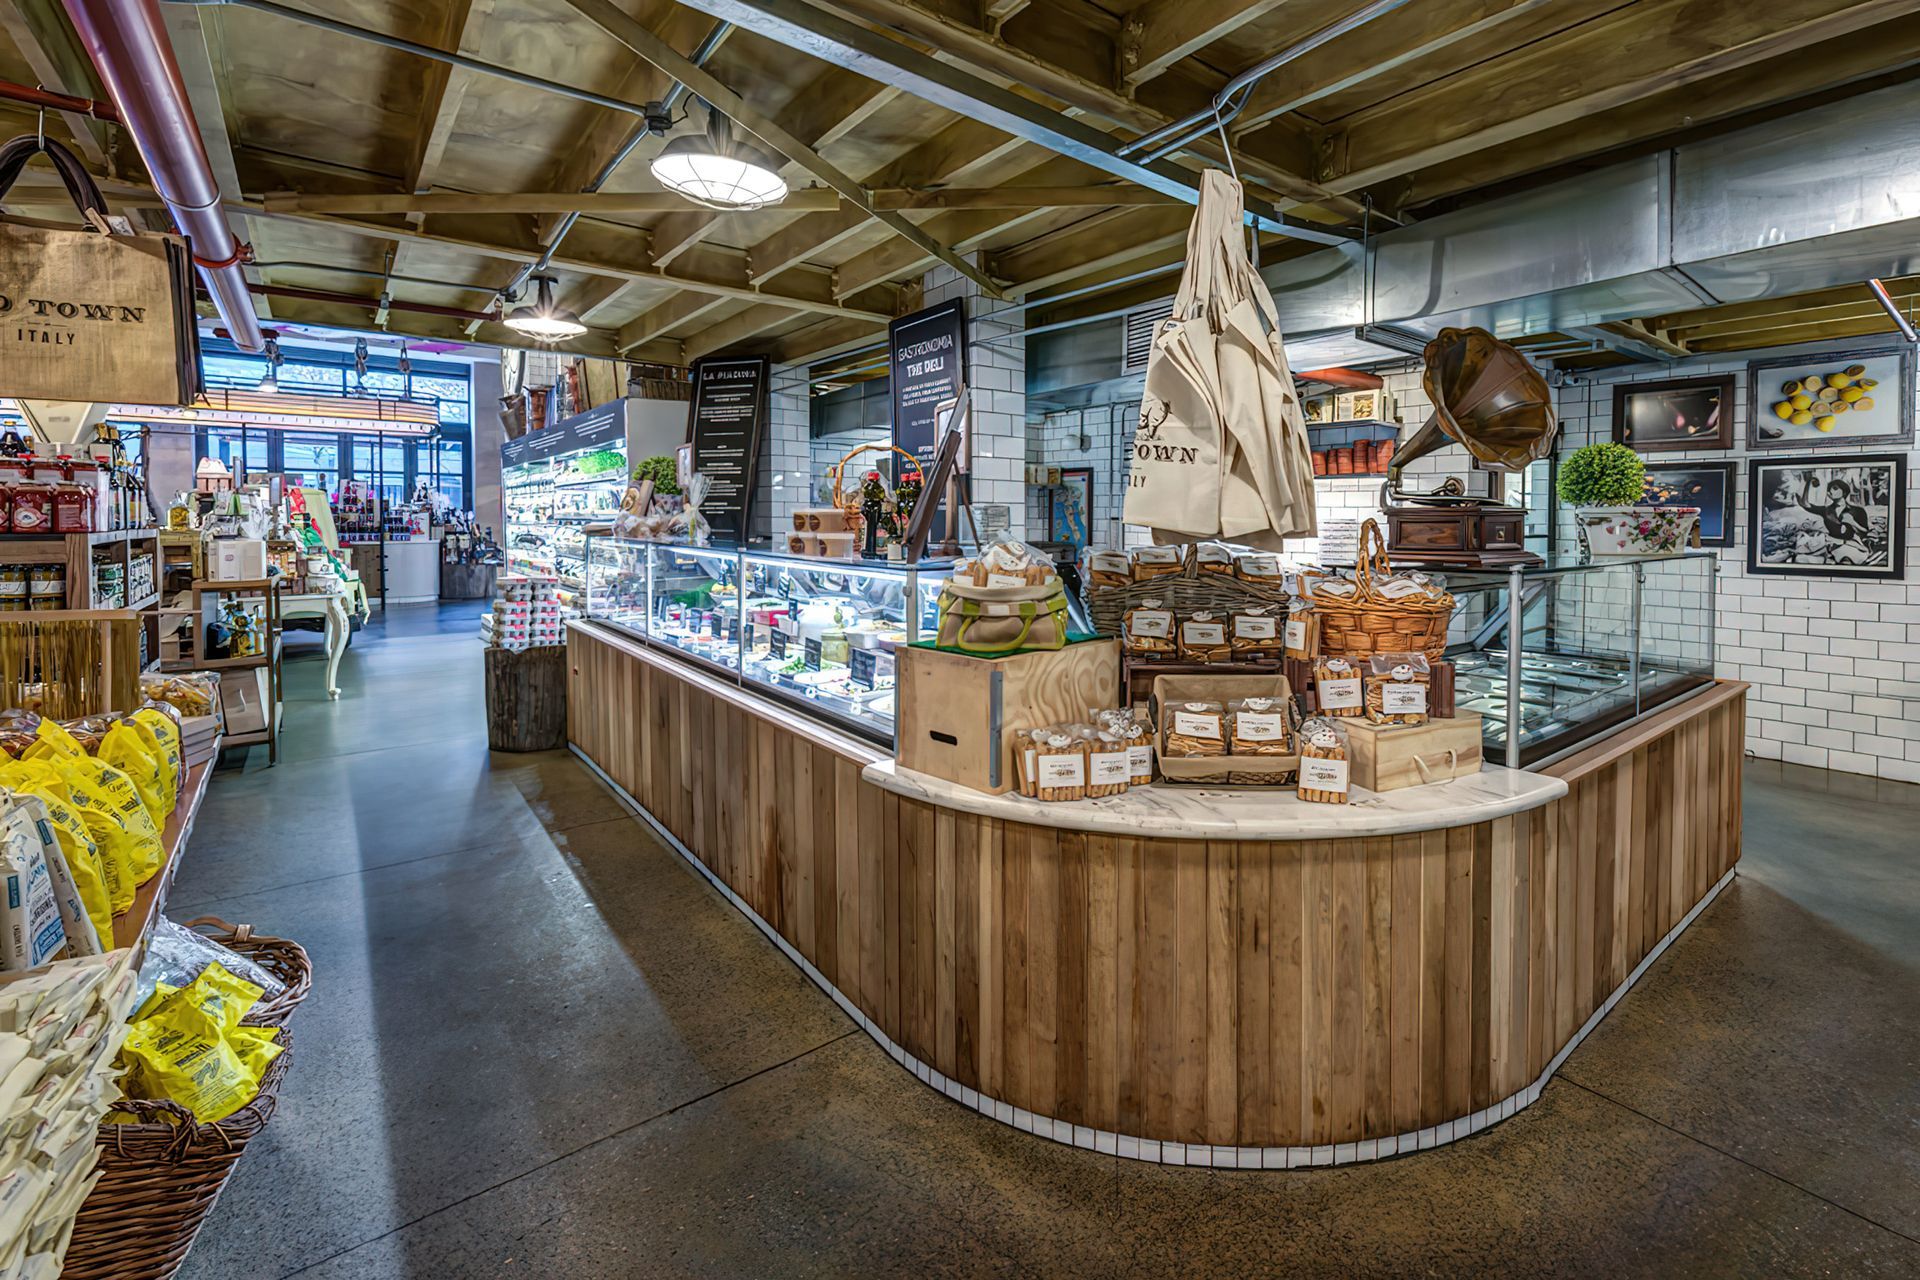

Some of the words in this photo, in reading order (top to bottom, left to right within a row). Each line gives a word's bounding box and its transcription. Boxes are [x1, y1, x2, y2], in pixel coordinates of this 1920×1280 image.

[28, 298, 147, 324] TOWN
[17, 328, 75, 345] ITALY
[906, 362, 923, 378] THE
[924, 356, 945, 373] DELI
